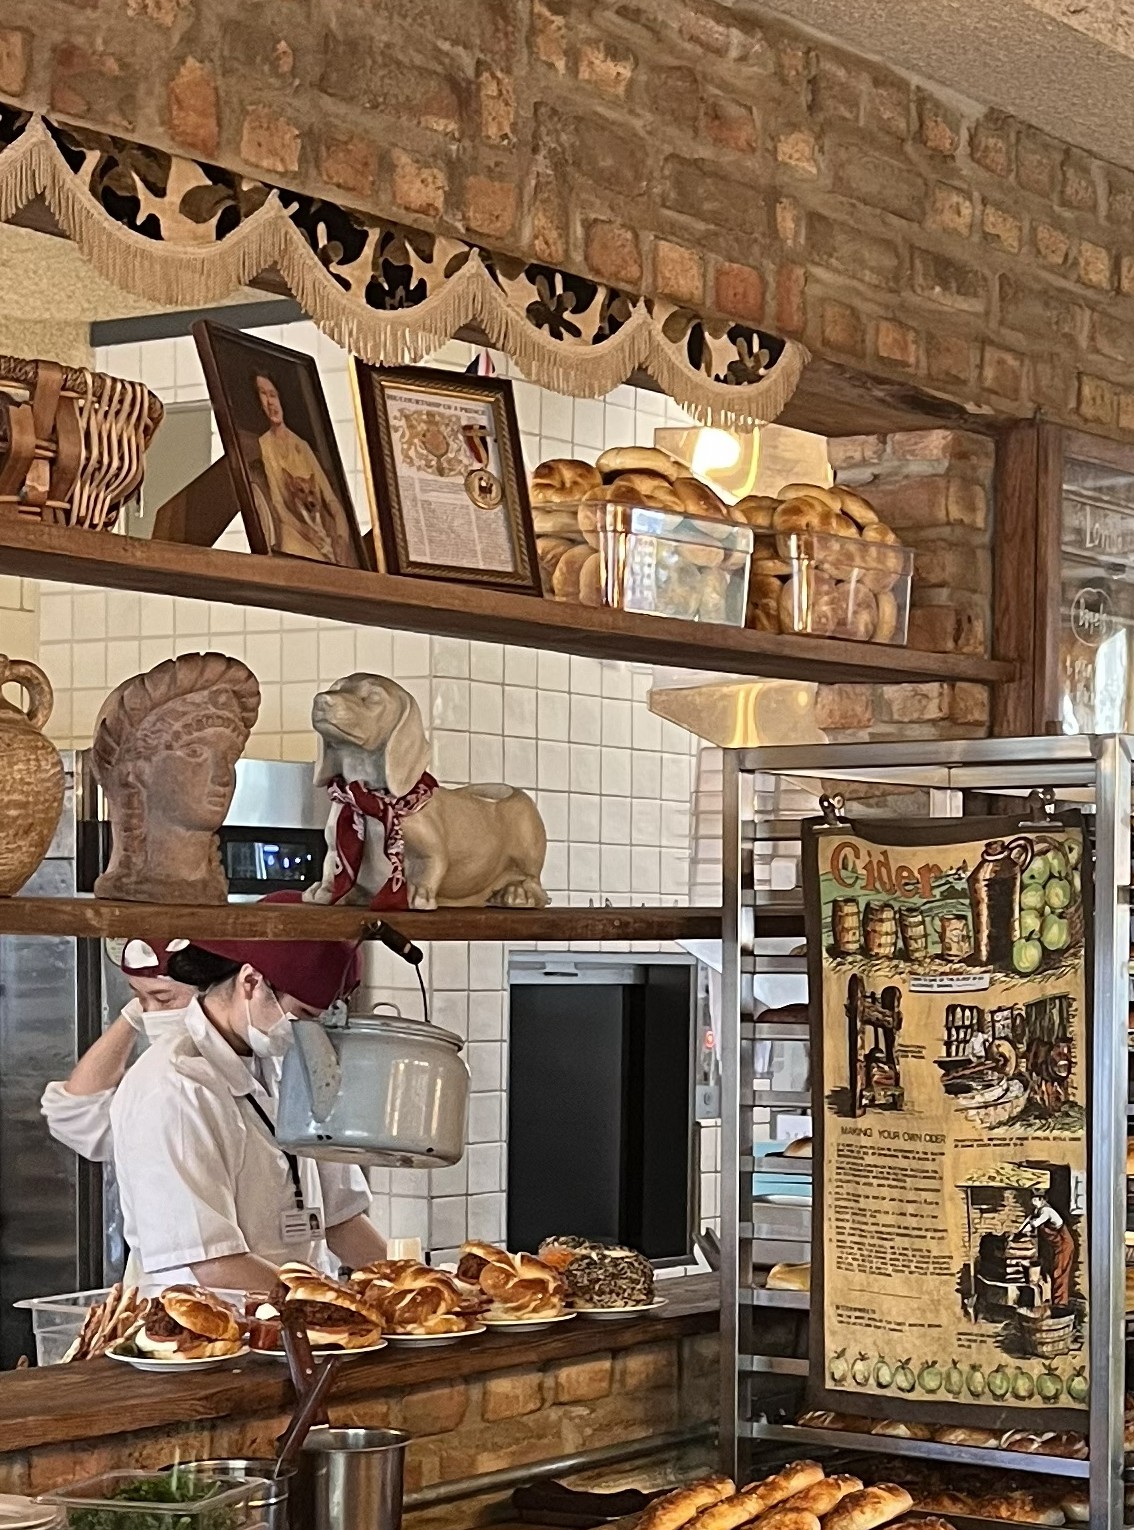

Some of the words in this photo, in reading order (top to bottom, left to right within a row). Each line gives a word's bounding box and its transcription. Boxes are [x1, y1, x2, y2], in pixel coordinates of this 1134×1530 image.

[830, 841, 943, 899] Cider
[841, 1126, 873, 1138] MAKING
[878, 1129, 901, 1141] YOUR
[902, 1131, 923, 1143] OWN
[924, 1133, 947, 1145] CIDER
